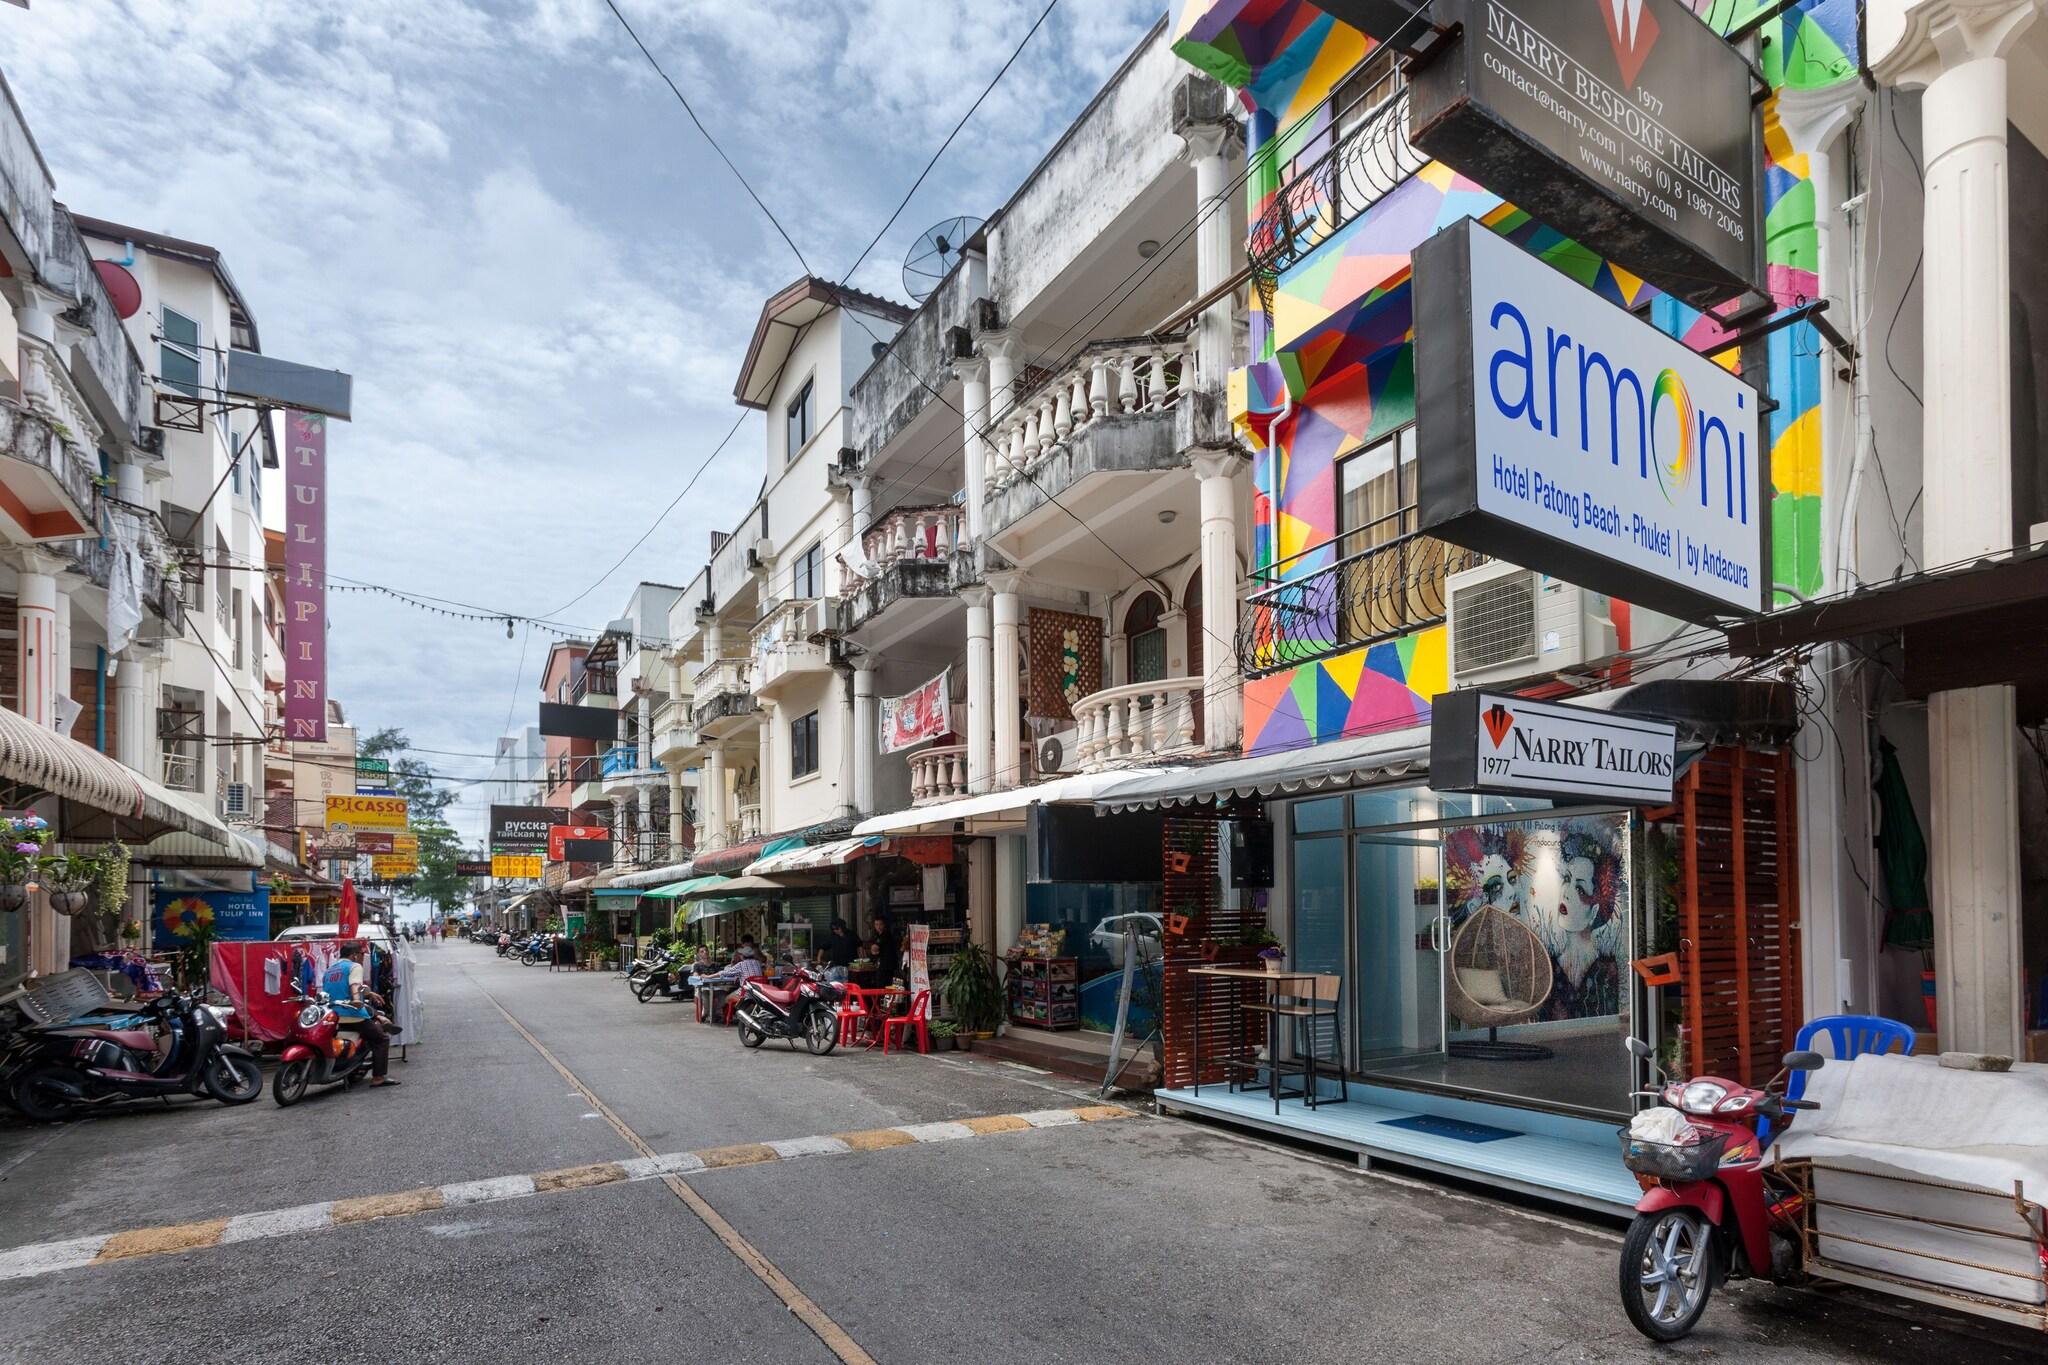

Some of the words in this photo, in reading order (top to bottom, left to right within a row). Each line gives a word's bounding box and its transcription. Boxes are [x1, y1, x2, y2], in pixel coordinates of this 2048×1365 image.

[1486, 5, 1569, 84] NARRY
[1575, 70, 1664, 155] BESPOKE
[1669, 138, 1741, 210] TAILORS
[1637, 86, 1663, 117] 1977
[1483, 51, 1617, 156] contact@narry.com
[1629, 155, 1652, 178] +66
[1655, 168, 1671, 195] (0)
[1674, 182, 1682, 199] 8
[1686, 189, 1713, 220] 1987
[1717, 209, 1744, 242] 2008
[1580, 146, 1678, 221] www.narry.com
[1489, 301, 1748, 525] armoni
[1493, 454, 1529, 501] Hotel
[1535, 472, 1579, 529] Patong
[1584, 492, 1621, 537] Beach
[1634, 513, 1671, 559] Phuket
[1687, 536, 1700, 576] by
[1702, 544, 1749, 590] Andacura
[1482, 757, 1511, 776] 1977
[1512, 727, 1589, 767] NARRY
[1591, 738, 1673, 778] TAILORS
[505, 821, 554, 832] русска
[219, 910, 244, 918] TULIP
[248, 910, 264, 918] INN
